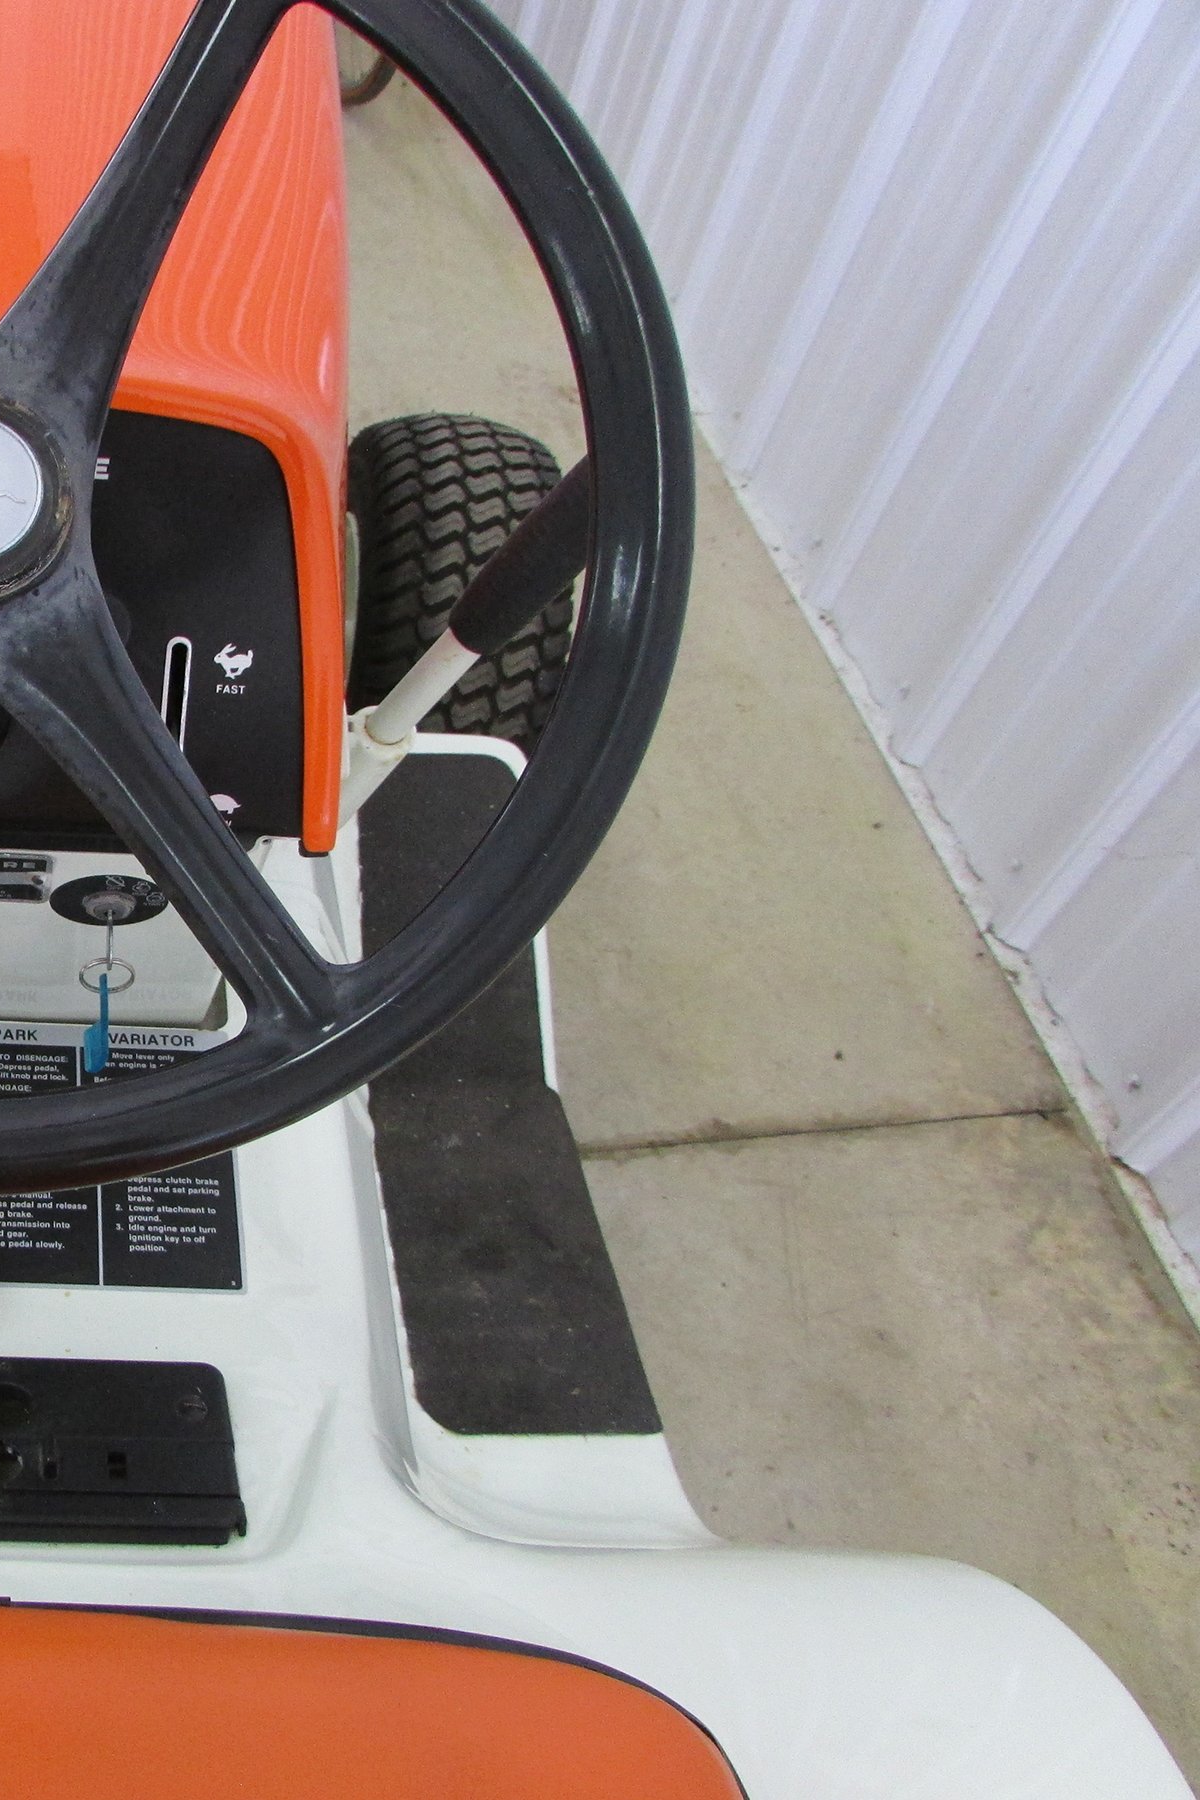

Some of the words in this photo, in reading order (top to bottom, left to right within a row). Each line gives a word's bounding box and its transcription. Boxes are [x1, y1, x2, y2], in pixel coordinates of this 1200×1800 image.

[215, 684, 246, 694] FAST
[108, 1033, 195, 1047] VARIATOR
[0, 1053, 11, 1061] TO
[16, 1054, 68, 1063] DISENGAGE:
[111, 1052, 133, 1060] Move
[157, 1054, 175, 1062] only
[165, 1176, 192, 1185] clutch
[195, 1178, 219, 1186] brake
[127, 1185, 152, 1194] pedal
[172, 1186, 186, 1194] set
[188, 1187, 220, 1197] parking
[127, 1194, 155, 1203] brake.
[10, 1200, 34, 1209] pedal
[37, 1201, 53, 1209] and
[55, 1202, 88, 1210] release
[115, 1204, 123, 1212] 2.
[156, 1206, 205, 1214] attachment
[7, 1210, 34, 1218] brake.
[128, 1214, 162, 1223] ground.
[53, 1221, 71, 1229] into
[147, 1225, 177, 1233] engine
[198, 1226, 217, 1234] turn
[6, 1230, 29, 1239] gear.
[164, 1234, 180, 1244] key
[182, 1235, 192, 1243] to
[8, 1240, 33, 1249] pedal
[35, 1240, 65, 1250] slowly.
[129, 1243, 167, 1252] position.
